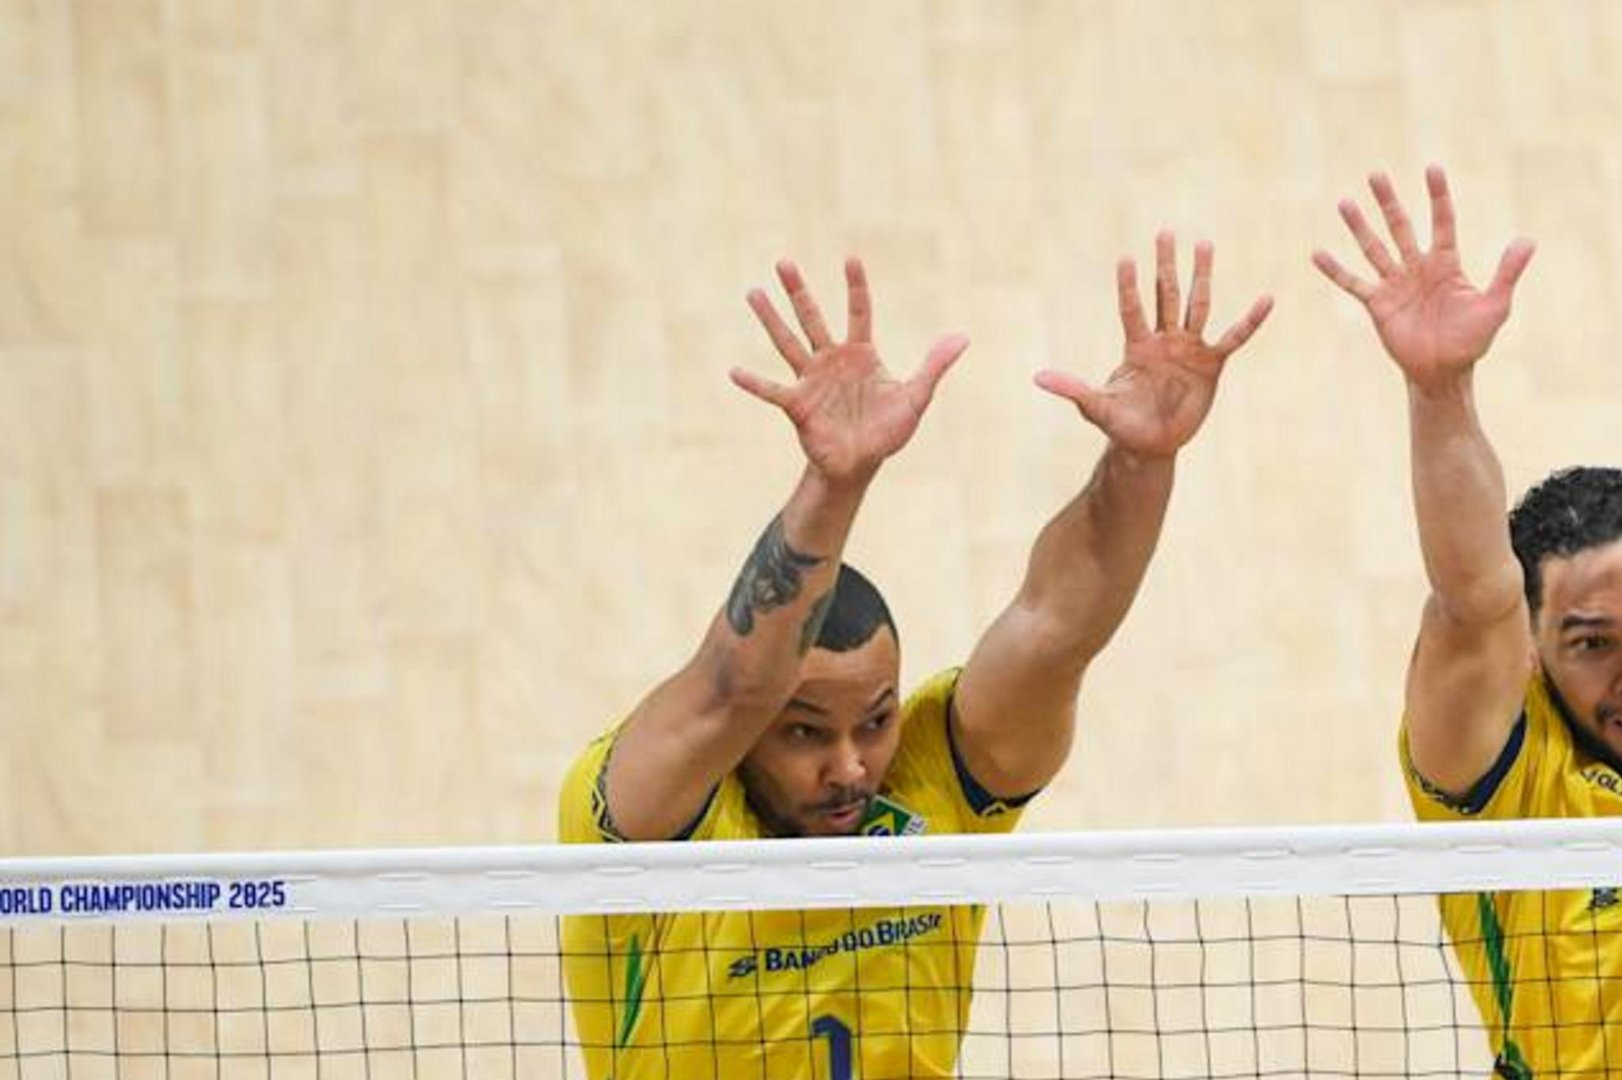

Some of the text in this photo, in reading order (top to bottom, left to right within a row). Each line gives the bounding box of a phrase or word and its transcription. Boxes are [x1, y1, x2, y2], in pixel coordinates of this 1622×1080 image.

[0, 881, 286, 914] ORLD CHAMPIONSHIP 2025
